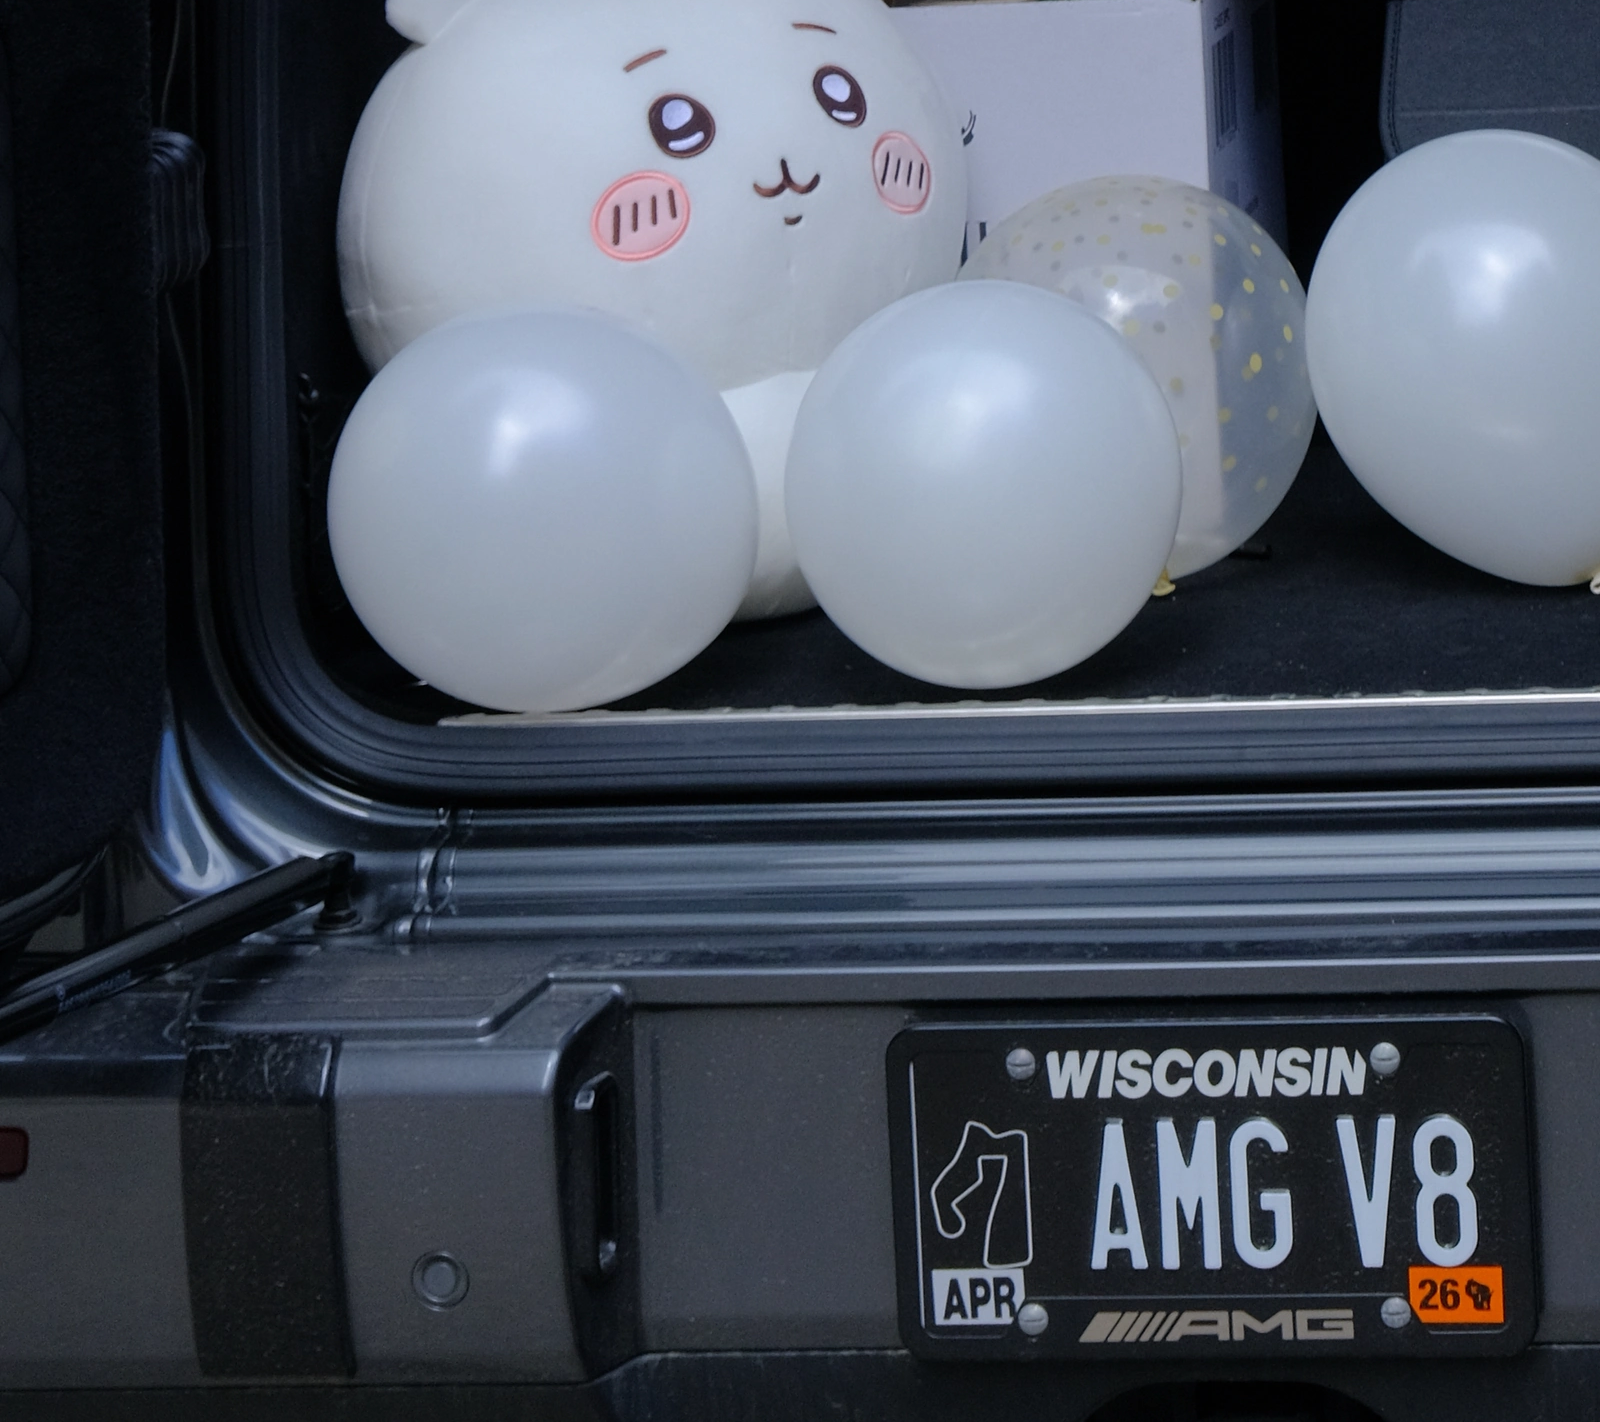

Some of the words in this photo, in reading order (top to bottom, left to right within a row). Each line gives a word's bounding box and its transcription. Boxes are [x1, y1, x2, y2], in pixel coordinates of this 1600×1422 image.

[1046, 1046, 1367, 1098] WISCONSIN
[1091, 1114, 1295, 1270] AMG
[1335, 1113, 1479, 1268] V8
[943, 1277, 1017, 1320] APR
[1418, 1279, 1461, 1310] 26
